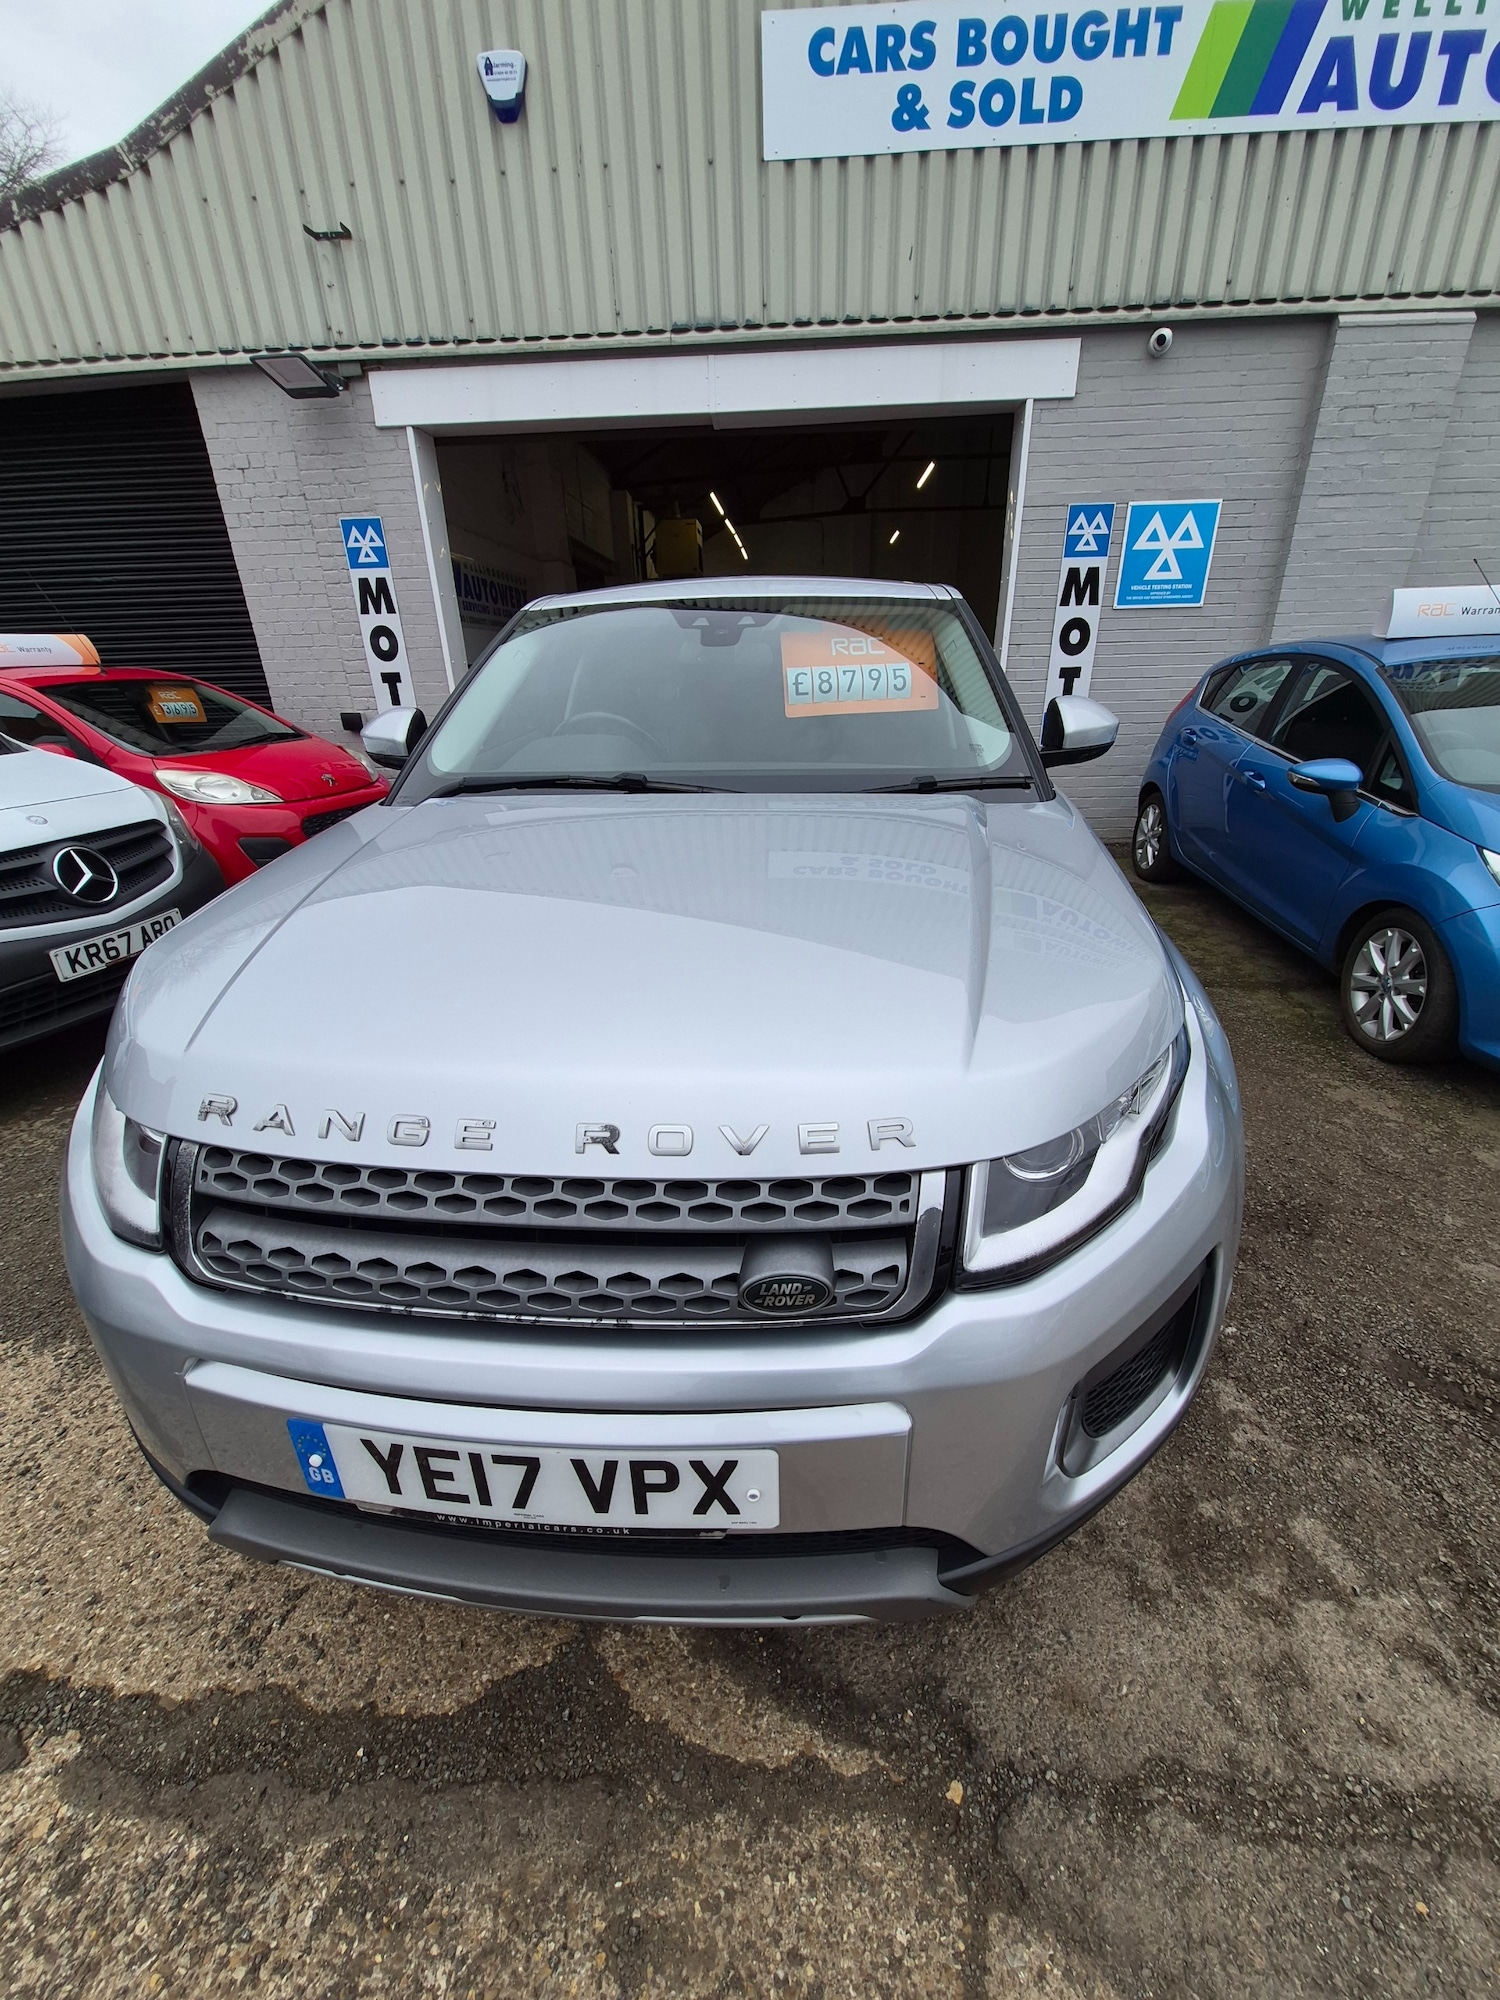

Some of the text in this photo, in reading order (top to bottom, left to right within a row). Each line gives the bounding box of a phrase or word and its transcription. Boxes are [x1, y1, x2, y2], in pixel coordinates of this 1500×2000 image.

[808, 5, 1183, 77] CARS BOUGHT
[891, 76, 1083, 132] & SOLD
[17, 646, 52, 655] Warranty
[358, 577, 402, 706] MOT
[1059, 566, 1100, 696] MOT
[792, 667, 907, 697] £8795
[64, 931, 131, 974] KR67
[197, 1092, 916, 1157] RANGE ROVER
[759, 1283, 802, 1296] LAND
[763, 1293, 815, 1307] ROVER
[308, 1467, 335, 1484] GB
[359, 1438, 741, 1515] YE17 VPX
[436, 1514, 630, 1535] www.imperialcars.co.uk
